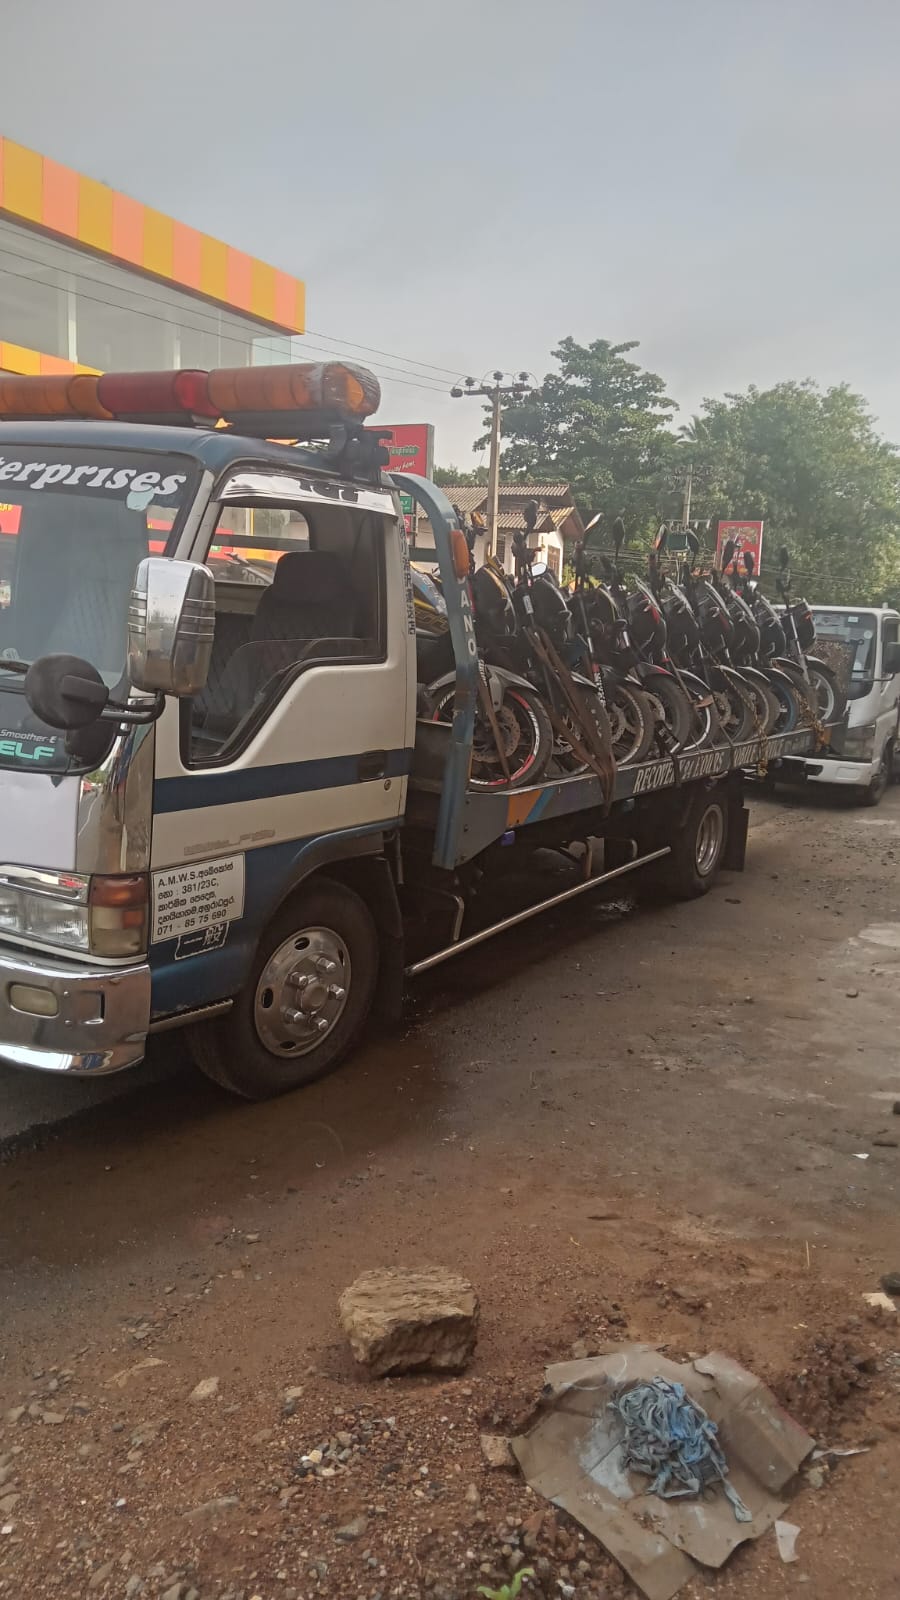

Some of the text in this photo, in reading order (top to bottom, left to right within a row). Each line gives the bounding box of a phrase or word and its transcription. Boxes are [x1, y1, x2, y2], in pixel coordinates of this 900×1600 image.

[0, 740, 55, 760] ELF
[157, 924, 173, 936] 071
[199, 913, 209, 924] 75
[212, 909, 227, 920] 690
